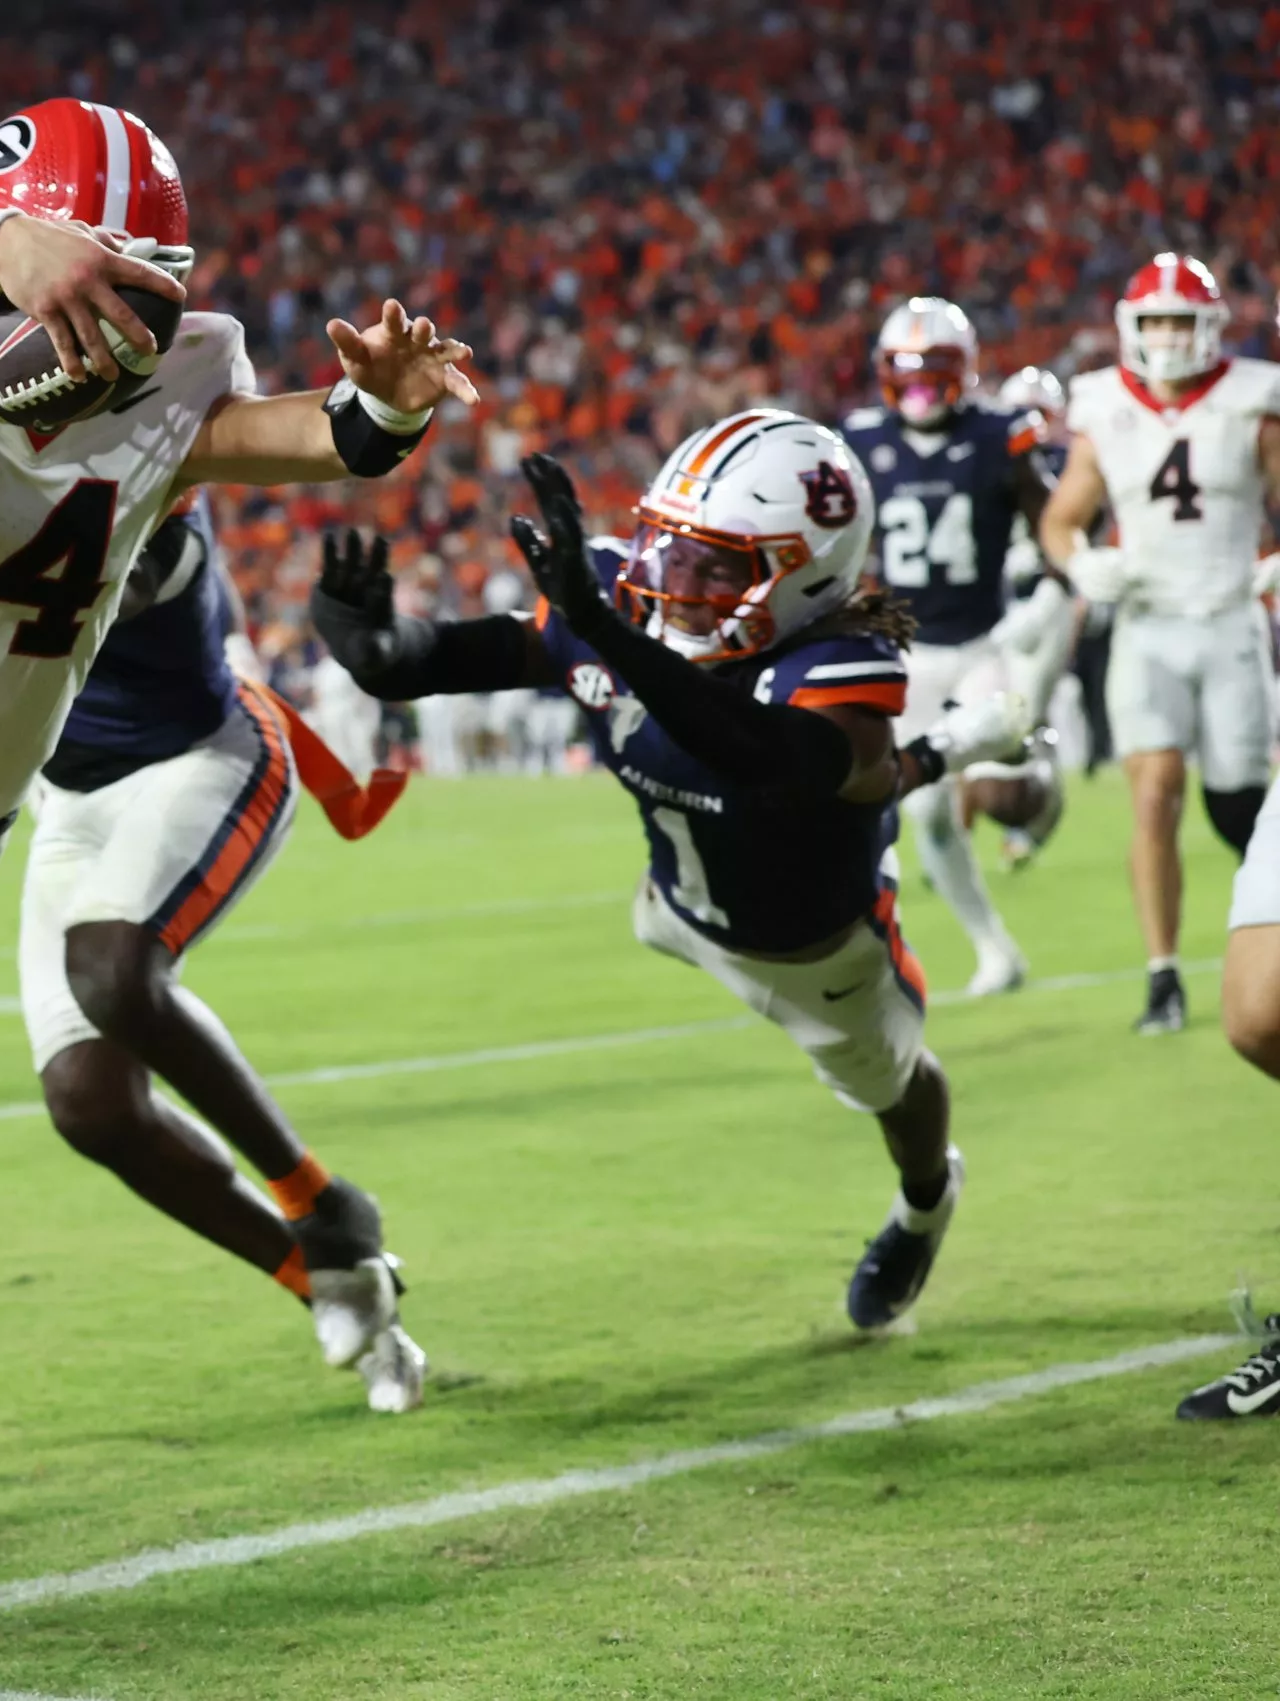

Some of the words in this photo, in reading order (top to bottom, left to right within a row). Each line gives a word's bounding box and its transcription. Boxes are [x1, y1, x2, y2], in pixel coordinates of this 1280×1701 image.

[1150, 438, 1202, 521] 4
[879, 493, 979, 588] 24
[652, 806, 730, 930] 1
